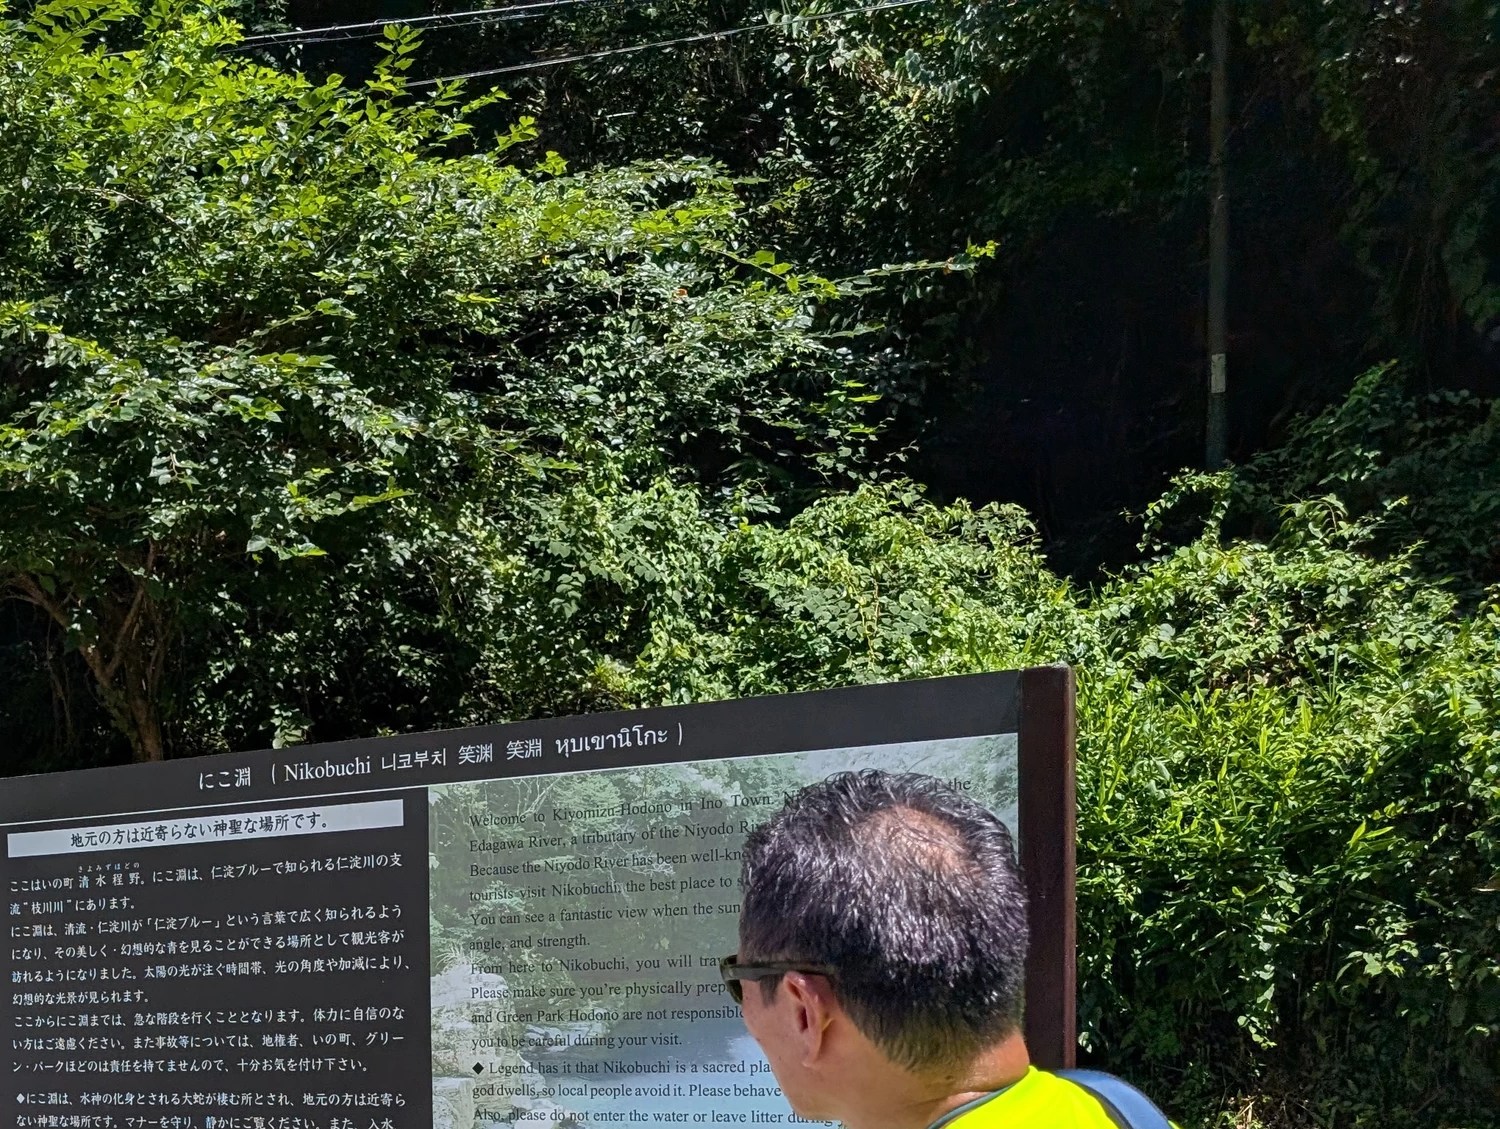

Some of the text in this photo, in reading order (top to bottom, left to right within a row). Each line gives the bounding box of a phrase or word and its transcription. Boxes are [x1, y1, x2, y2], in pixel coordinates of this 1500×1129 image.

[199, 766, 251, 791] にこ淵
[284, 756, 371, 782] Nikobuchi
[381, 748, 447, 771] 니코부치
[555, 724, 668, 758] หุบเขานิโกะ
[470, 814, 526, 828] Welcome
[533, 811, 545, 823] to
[553, 802, 672, 823] Kiyomizu-Hodono
[680, 800, 692, 811] in
[700, 797, 723, 809] Ino
[731, 794, 775, 807] Town.
[70, 811, 329, 848] 地元の方は近寄らない神聖な場所です。
[470, 838, 524, 854] Edagawa
[529, 836, 567, 850] River,
[570, 836, 578, 845] a
[582, 830, 636, 846] tributary
[641, 828, 656, 841] of
[659, 826, 679, 839] the
[684, 822, 734, 839] Niyodo
[470, 864, 520, 878] Because
[523, 862, 541, 874] the
[545, 858, 590, 875] Niyodo
[594, 857, 630, 870] River
[632, 854, 653, 867] has
[656, 852, 688, 865] been
[470, 889, 514, 901] tourists
[519, 885, 546, 898] visit
[626, 879, 646, 893] the
[649, 878, 676, 891] best
[680, 876, 716, 893] place
[719, 876, 732, 888] to
[470, 914, 496, 927] You
[500, 914, 521, 925] can
[525, 913, 545, 923] see
[548, 913, 556, 923] a
[560, 907, 613, 922] fantastic
[617, 906, 649, 919] view
[653, 903, 689, 917] when
[693, 902, 713, 916] the
[469, 934, 591, 951] angle, and strength.
[470, 962, 502, 975] From
[509, 960, 536, 973] here
[541, 961, 553, 973] to
[559, 956, 630, 973] Nikobuchi,
[635, 959, 661, 973] you
[667, 954, 693, 968] will
[12, 988, 149, 1006] 幻想的な光景が見られます。
[470, 986, 509, 999] Please
[513, 985, 547, 998] make
[549, 986, 576, 997] sure
[625, 980, 692, 997] physically
[696, 982, 728, 997] prep
[470, 1011, 493, 1024] and
[496, 1010, 533, 1023] Green
[537, 1009, 565, 1022] Park
[568, 1008, 620, 1022] Hodono
[622, 1011, 643, 1021] are
[646, 1009, 667, 1020] not
[471, 1032, 683, 1051] you to be careful during your visit.
[489, 1060, 772, 1078] Legend has it that Nikobuchi is a sacred pla
[472, 1085, 495, 1101] god
[496, 1084, 538, 1100] dwells,
[541, 1087, 556, 1098] so
[558, 1084, 588, 1098] local
[590, 1084, 633, 1101] people
[634, 1084, 671, 1098] avoid
[672, 1084, 686, 1098] it.
[689, 1084, 731, 1098] Please
[472, 1109, 505, 1124] Also,
[508, 1109, 546, 1125] please
[549, 1109, 564, 1122] do
[568, 1111, 590, 1122] not
[593, 1111, 625, 1122] enter
[628, 1109, 649, 1122] the
[652, 1111, 689, 1123] water
[693, 1113, 708, 1123] or
[711, 1109, 747, 1123] leave
[751, 1110, 784, 1123] litter
